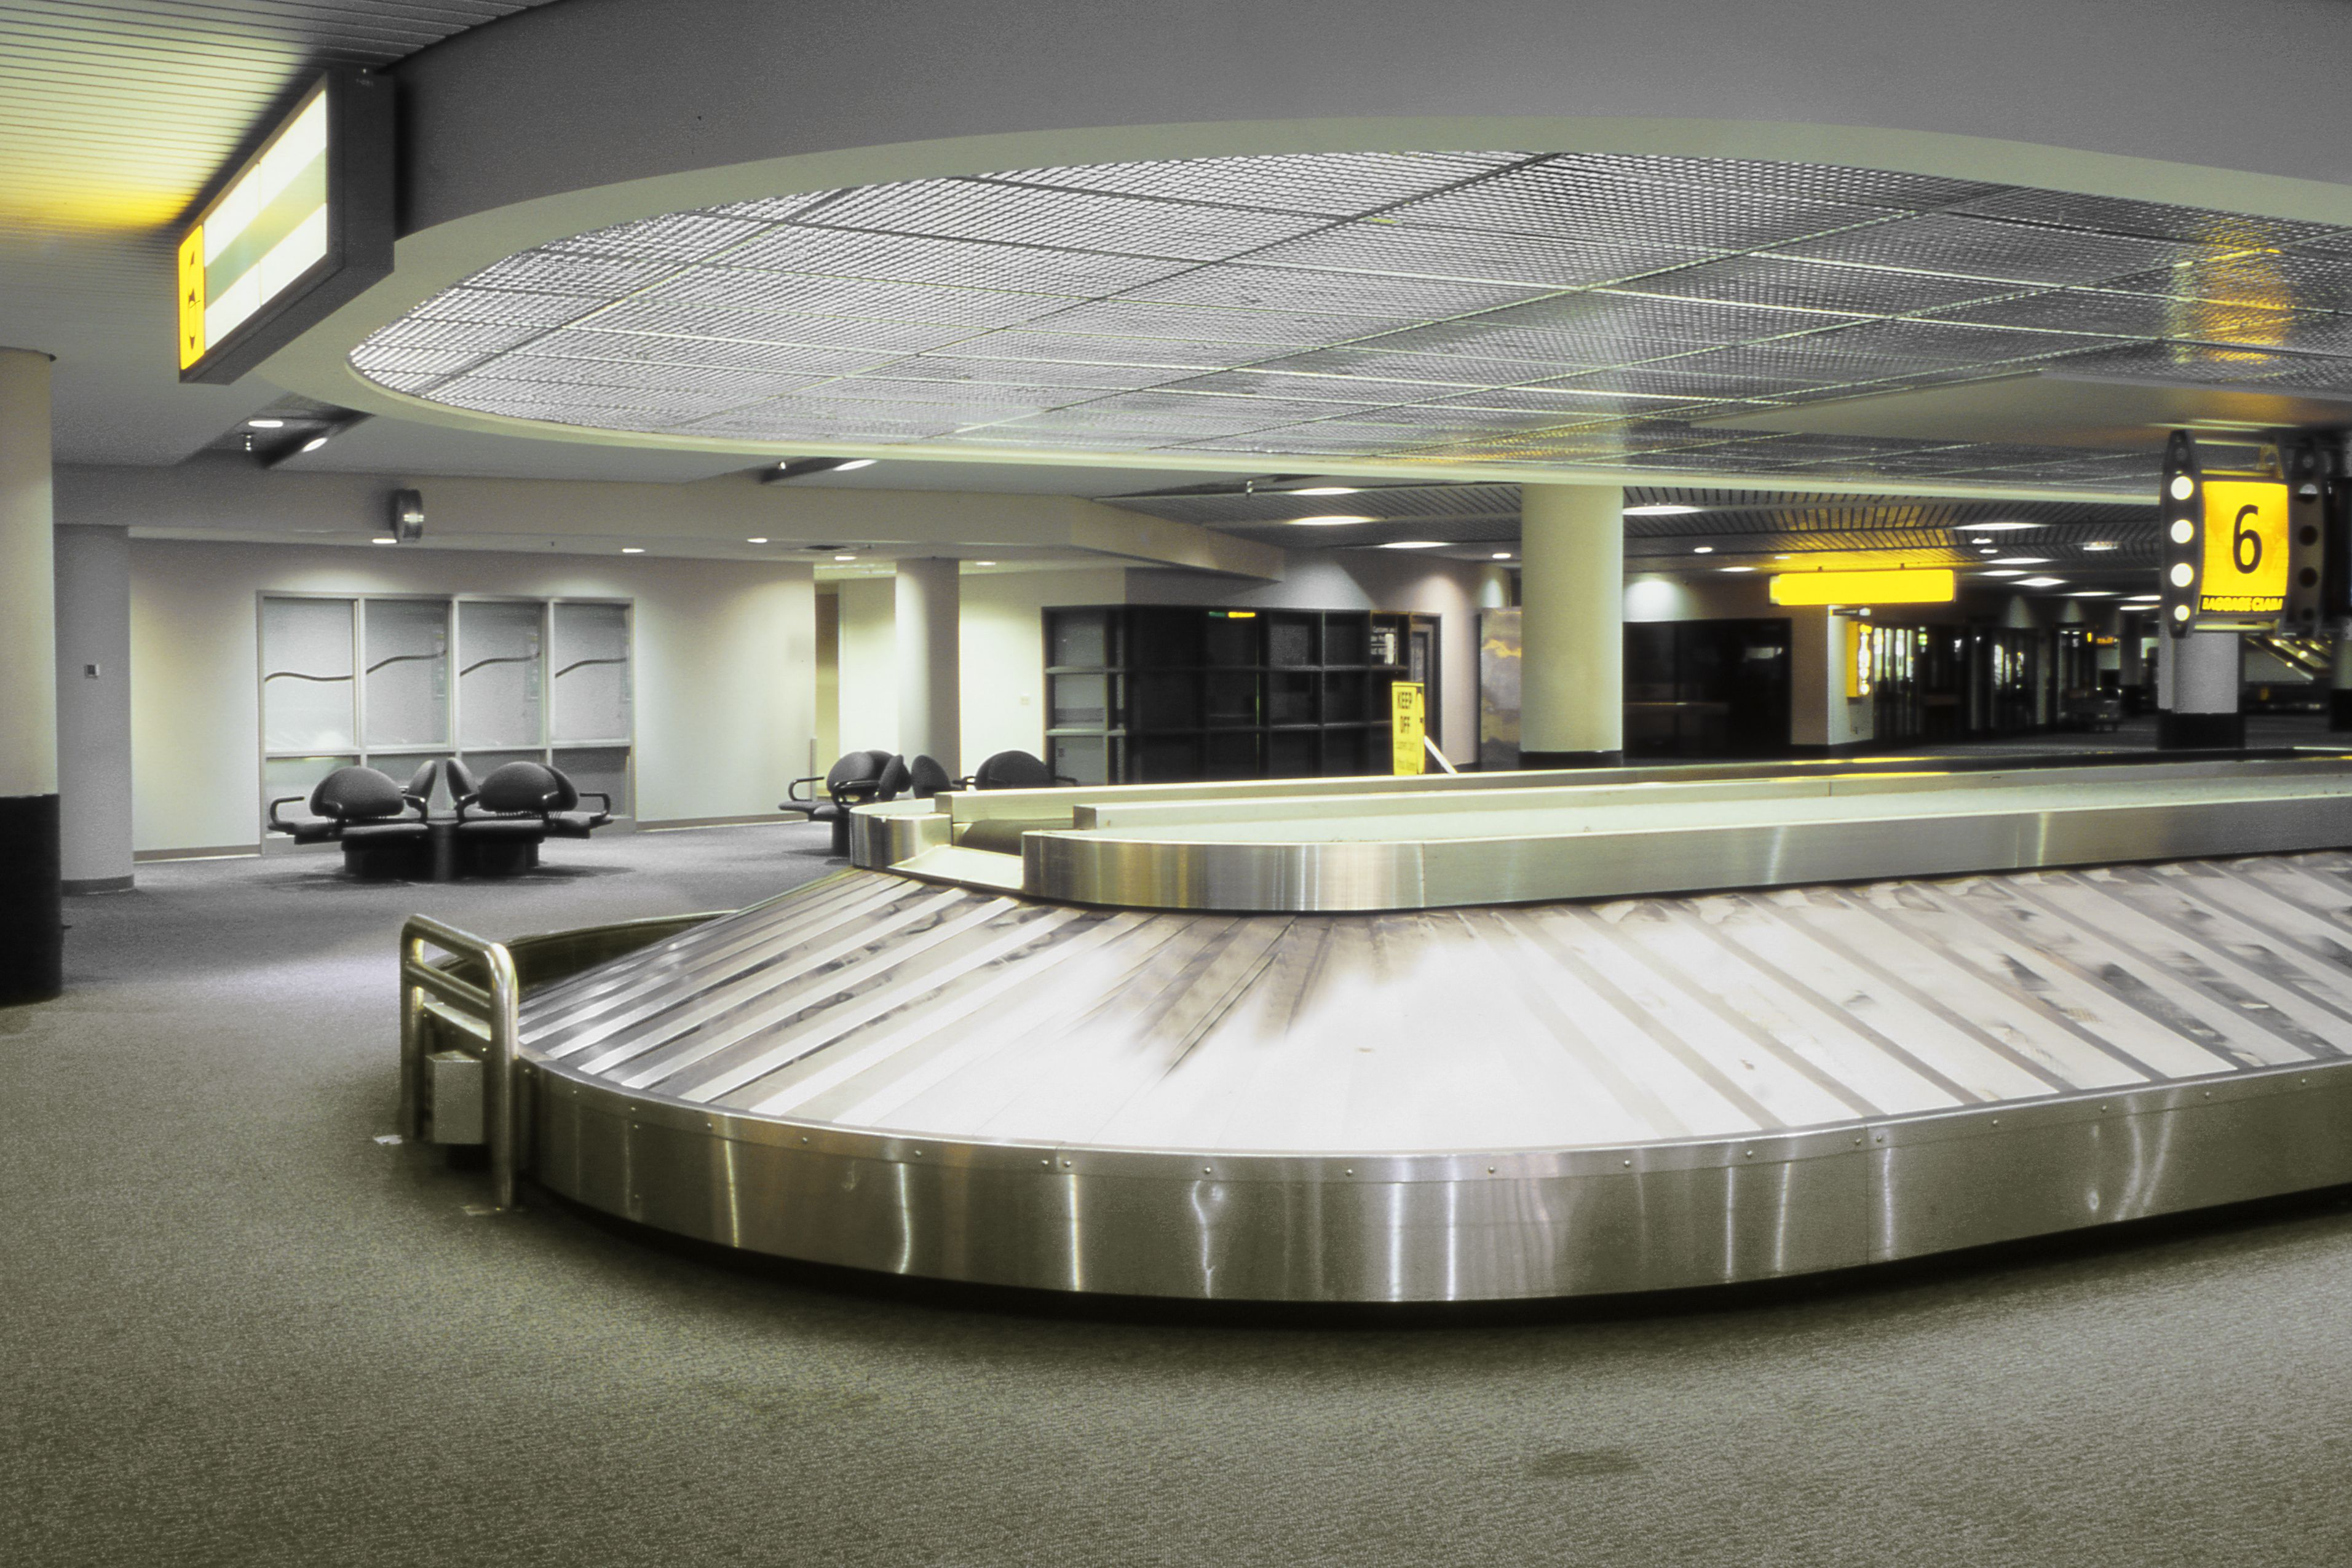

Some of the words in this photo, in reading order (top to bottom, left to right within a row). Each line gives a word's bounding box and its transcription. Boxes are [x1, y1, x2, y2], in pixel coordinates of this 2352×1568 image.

[2233, 504, 2262, 574] 6
[2202, 596, 2251, 611] BAGGAGE
[2251, 597, 2283, 611] CLAIM
[1397, 692, 1412, 709] KEEP
[1400, 716, 1410, 734] OFF
